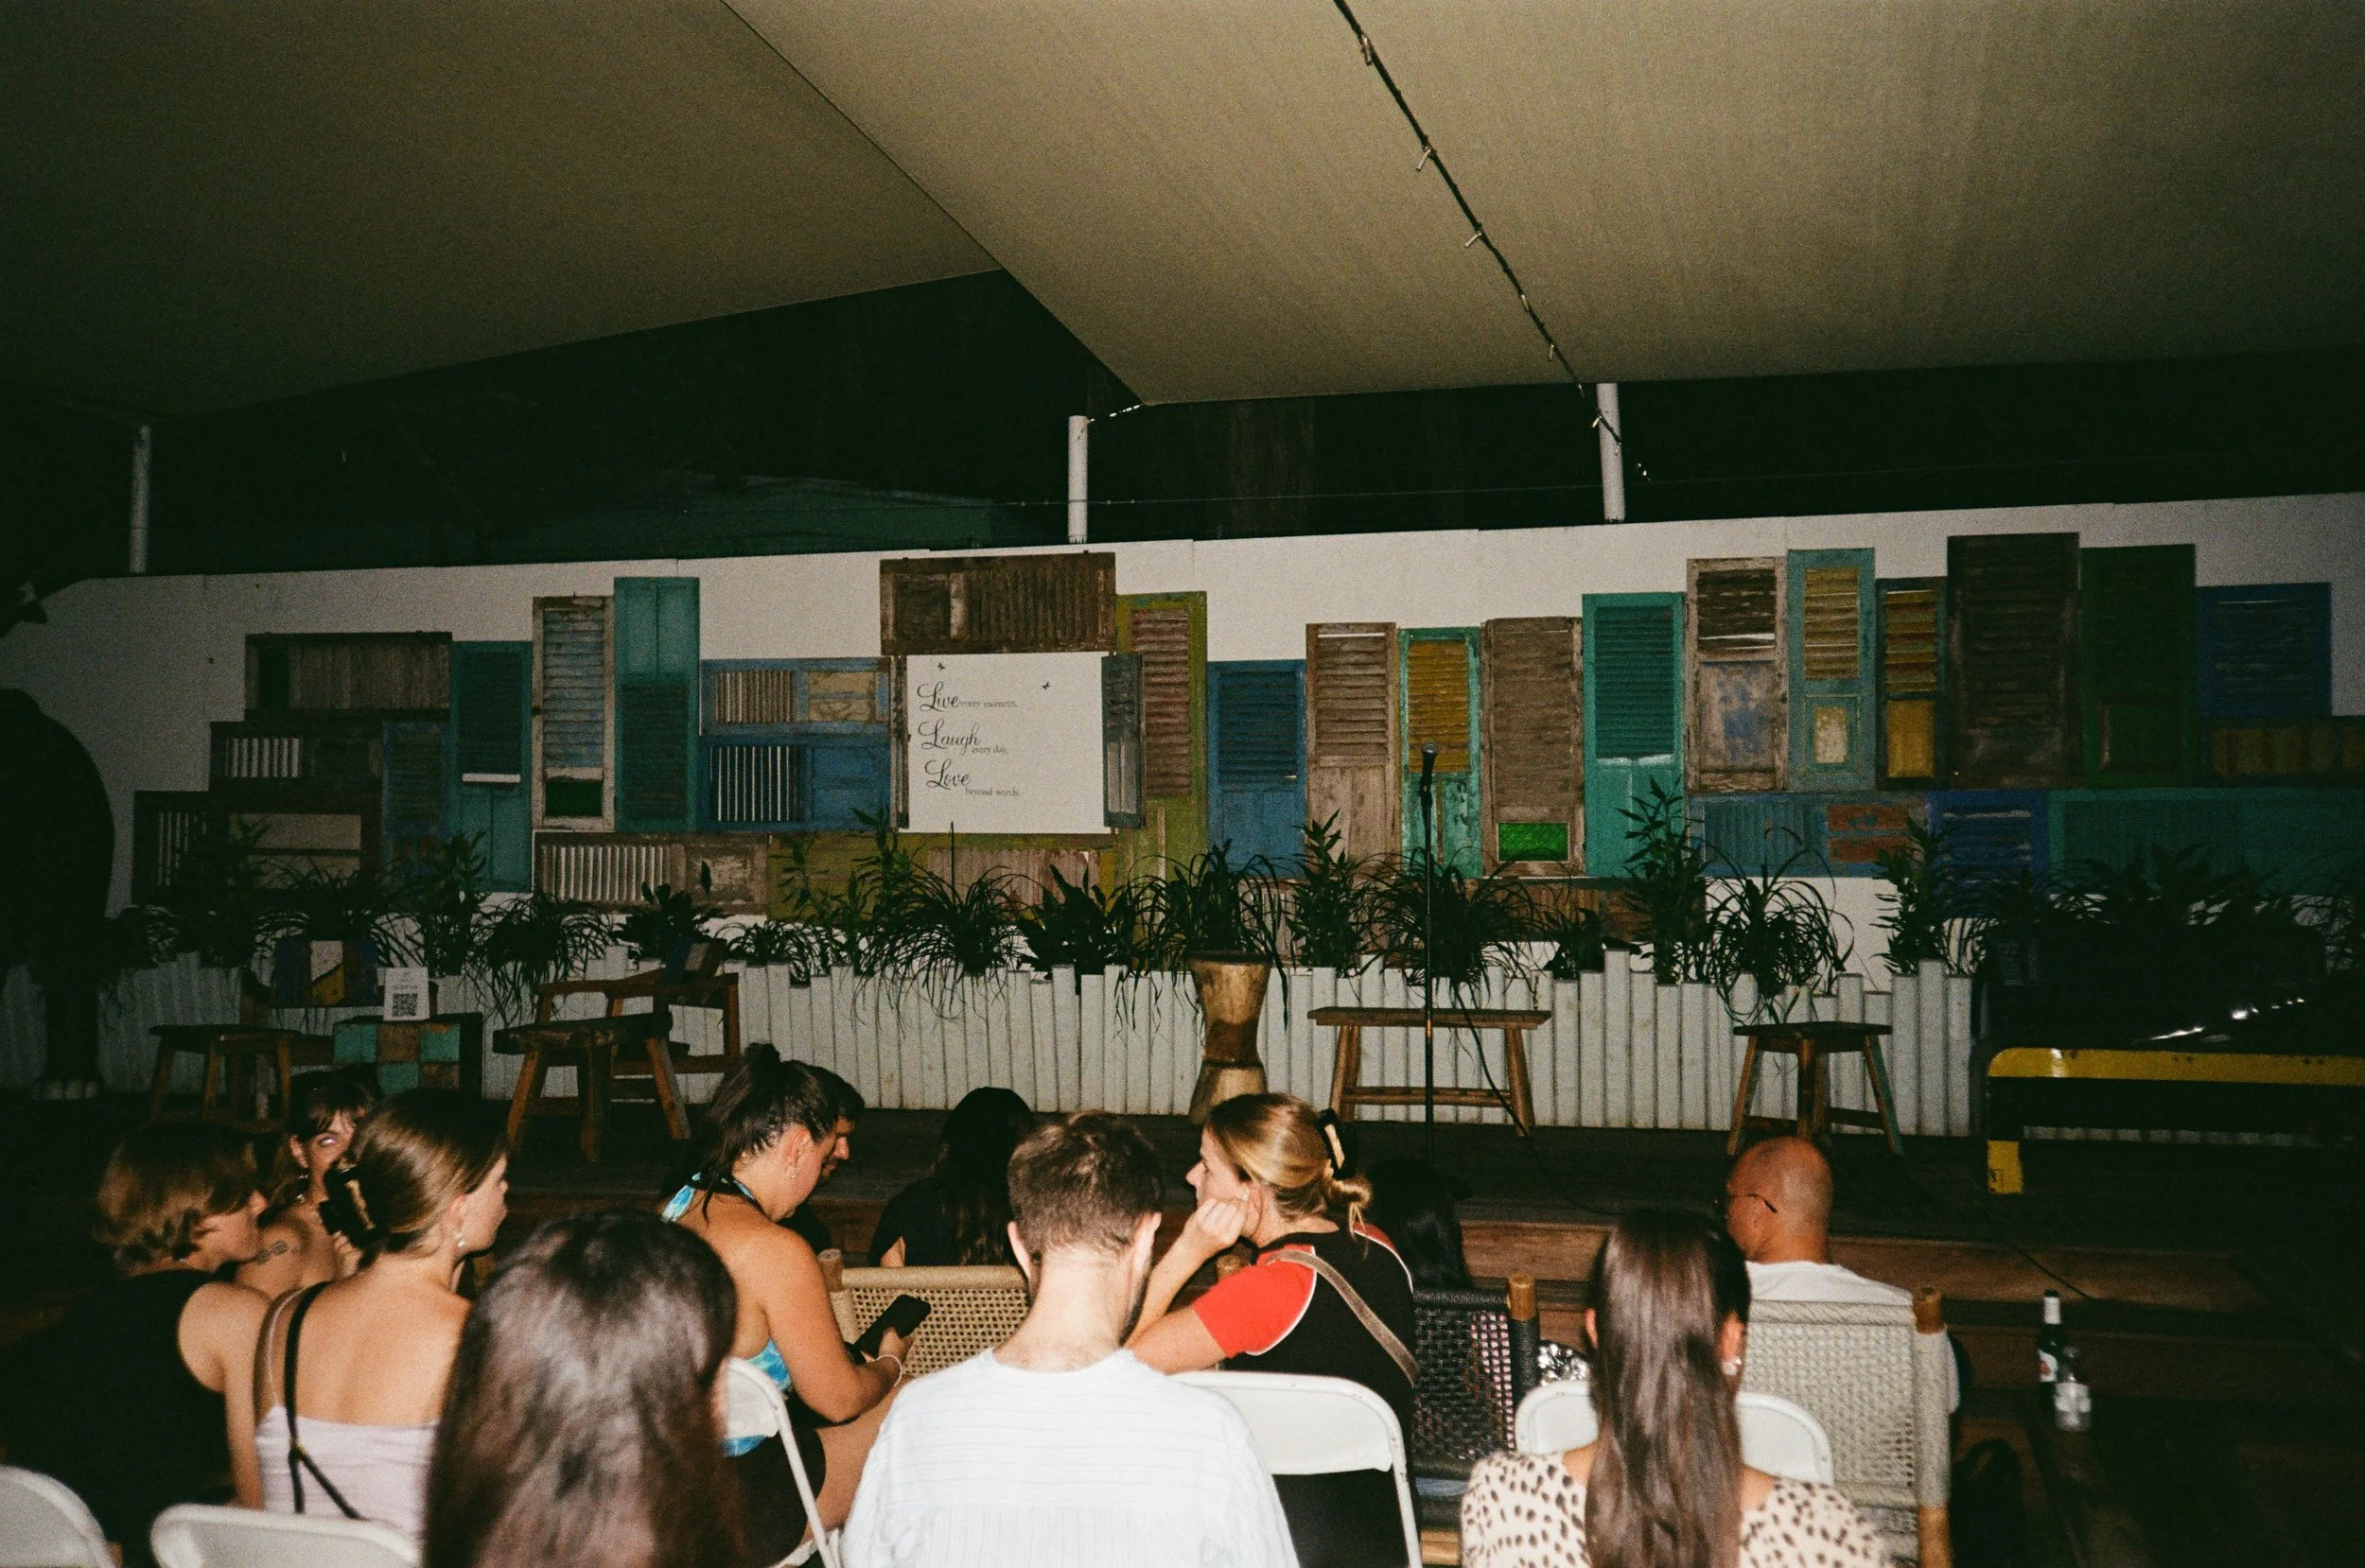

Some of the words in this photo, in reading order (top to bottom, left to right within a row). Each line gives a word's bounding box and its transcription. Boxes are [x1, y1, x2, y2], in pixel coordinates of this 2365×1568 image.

[917, 681, 959, 712] Live
[960, 701, 980, 710] every
[918, 719, 980, 756] Laugh
[972, 745, 990, 755] every
[924, 758, 971, 790] Love
[965, 787, 992, 796] beyond
